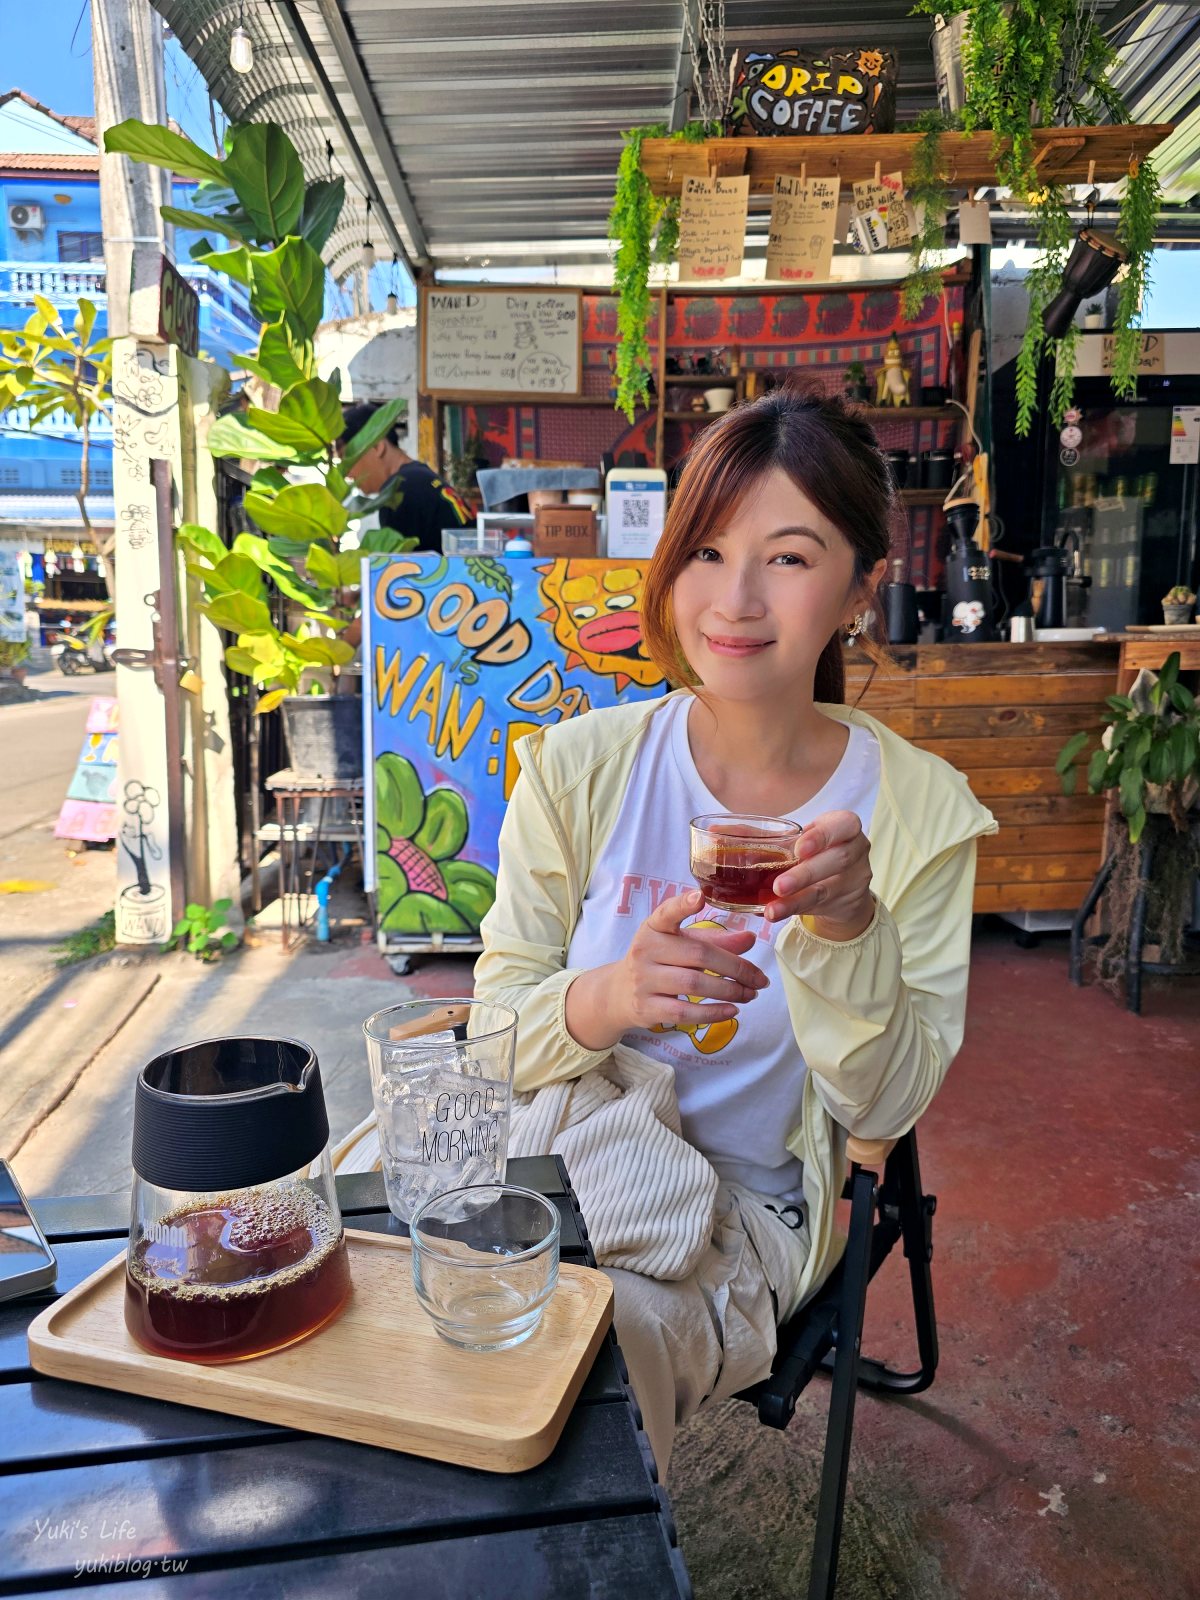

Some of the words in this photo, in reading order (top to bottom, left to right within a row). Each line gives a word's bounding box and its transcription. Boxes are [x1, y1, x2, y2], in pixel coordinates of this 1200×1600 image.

[761, 64, 863, 97] DRIP
[751, 89, 862, 134] COFFEE
[544, 525, 561, 537] TIP
[565, 525, 589, 538] BOX
[374, 561, 532, 667] GOOD
[506, 660, 593, 722] DA
[450, 650, 482, 686] is
[640, 1035, 662, 1047] BAD
[663, 1041, 693, 1062] VIBES
[694, 1056, 733, 1067] TODAY
[436, 1087, 495, 1123] GOOD
[422, 1119, 498, 1164] MORNING
